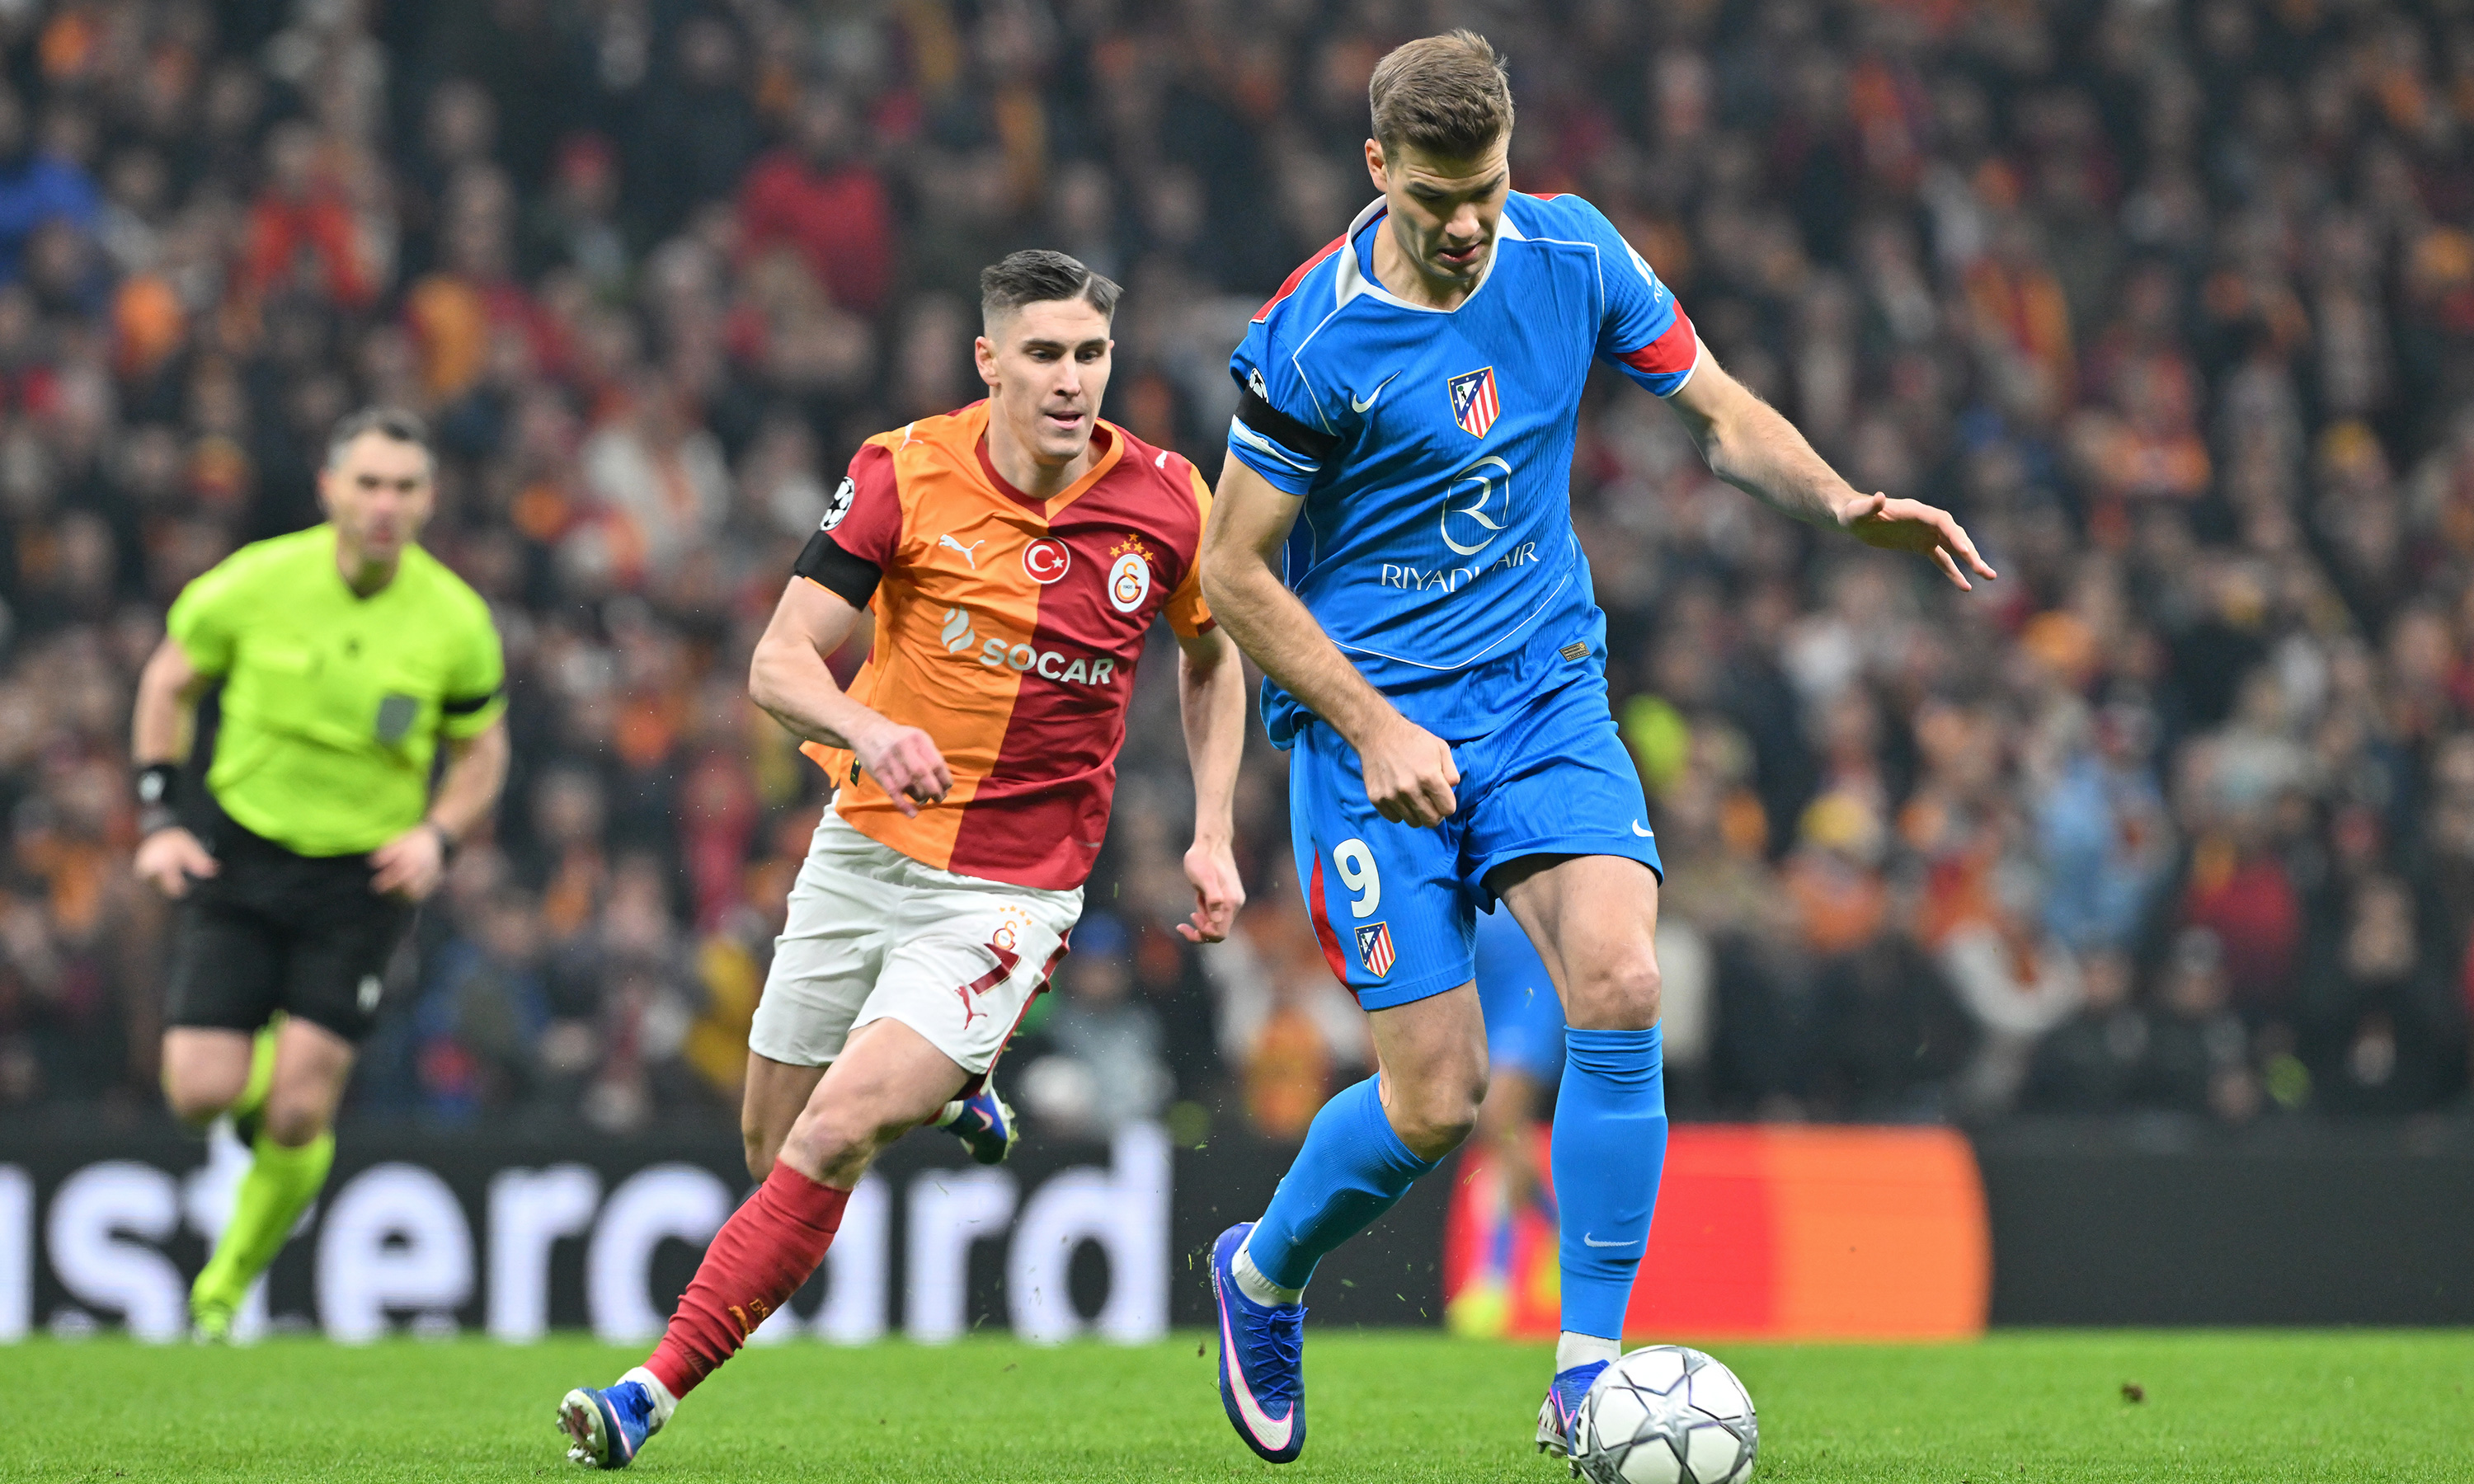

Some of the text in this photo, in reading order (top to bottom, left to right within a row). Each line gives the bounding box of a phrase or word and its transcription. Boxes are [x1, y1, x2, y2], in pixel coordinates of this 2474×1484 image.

[1492, 541, 1540, 571] AIR
[978, 637, 1115, 686] SOCAR
[1333, 838, 1380, 918] 9
